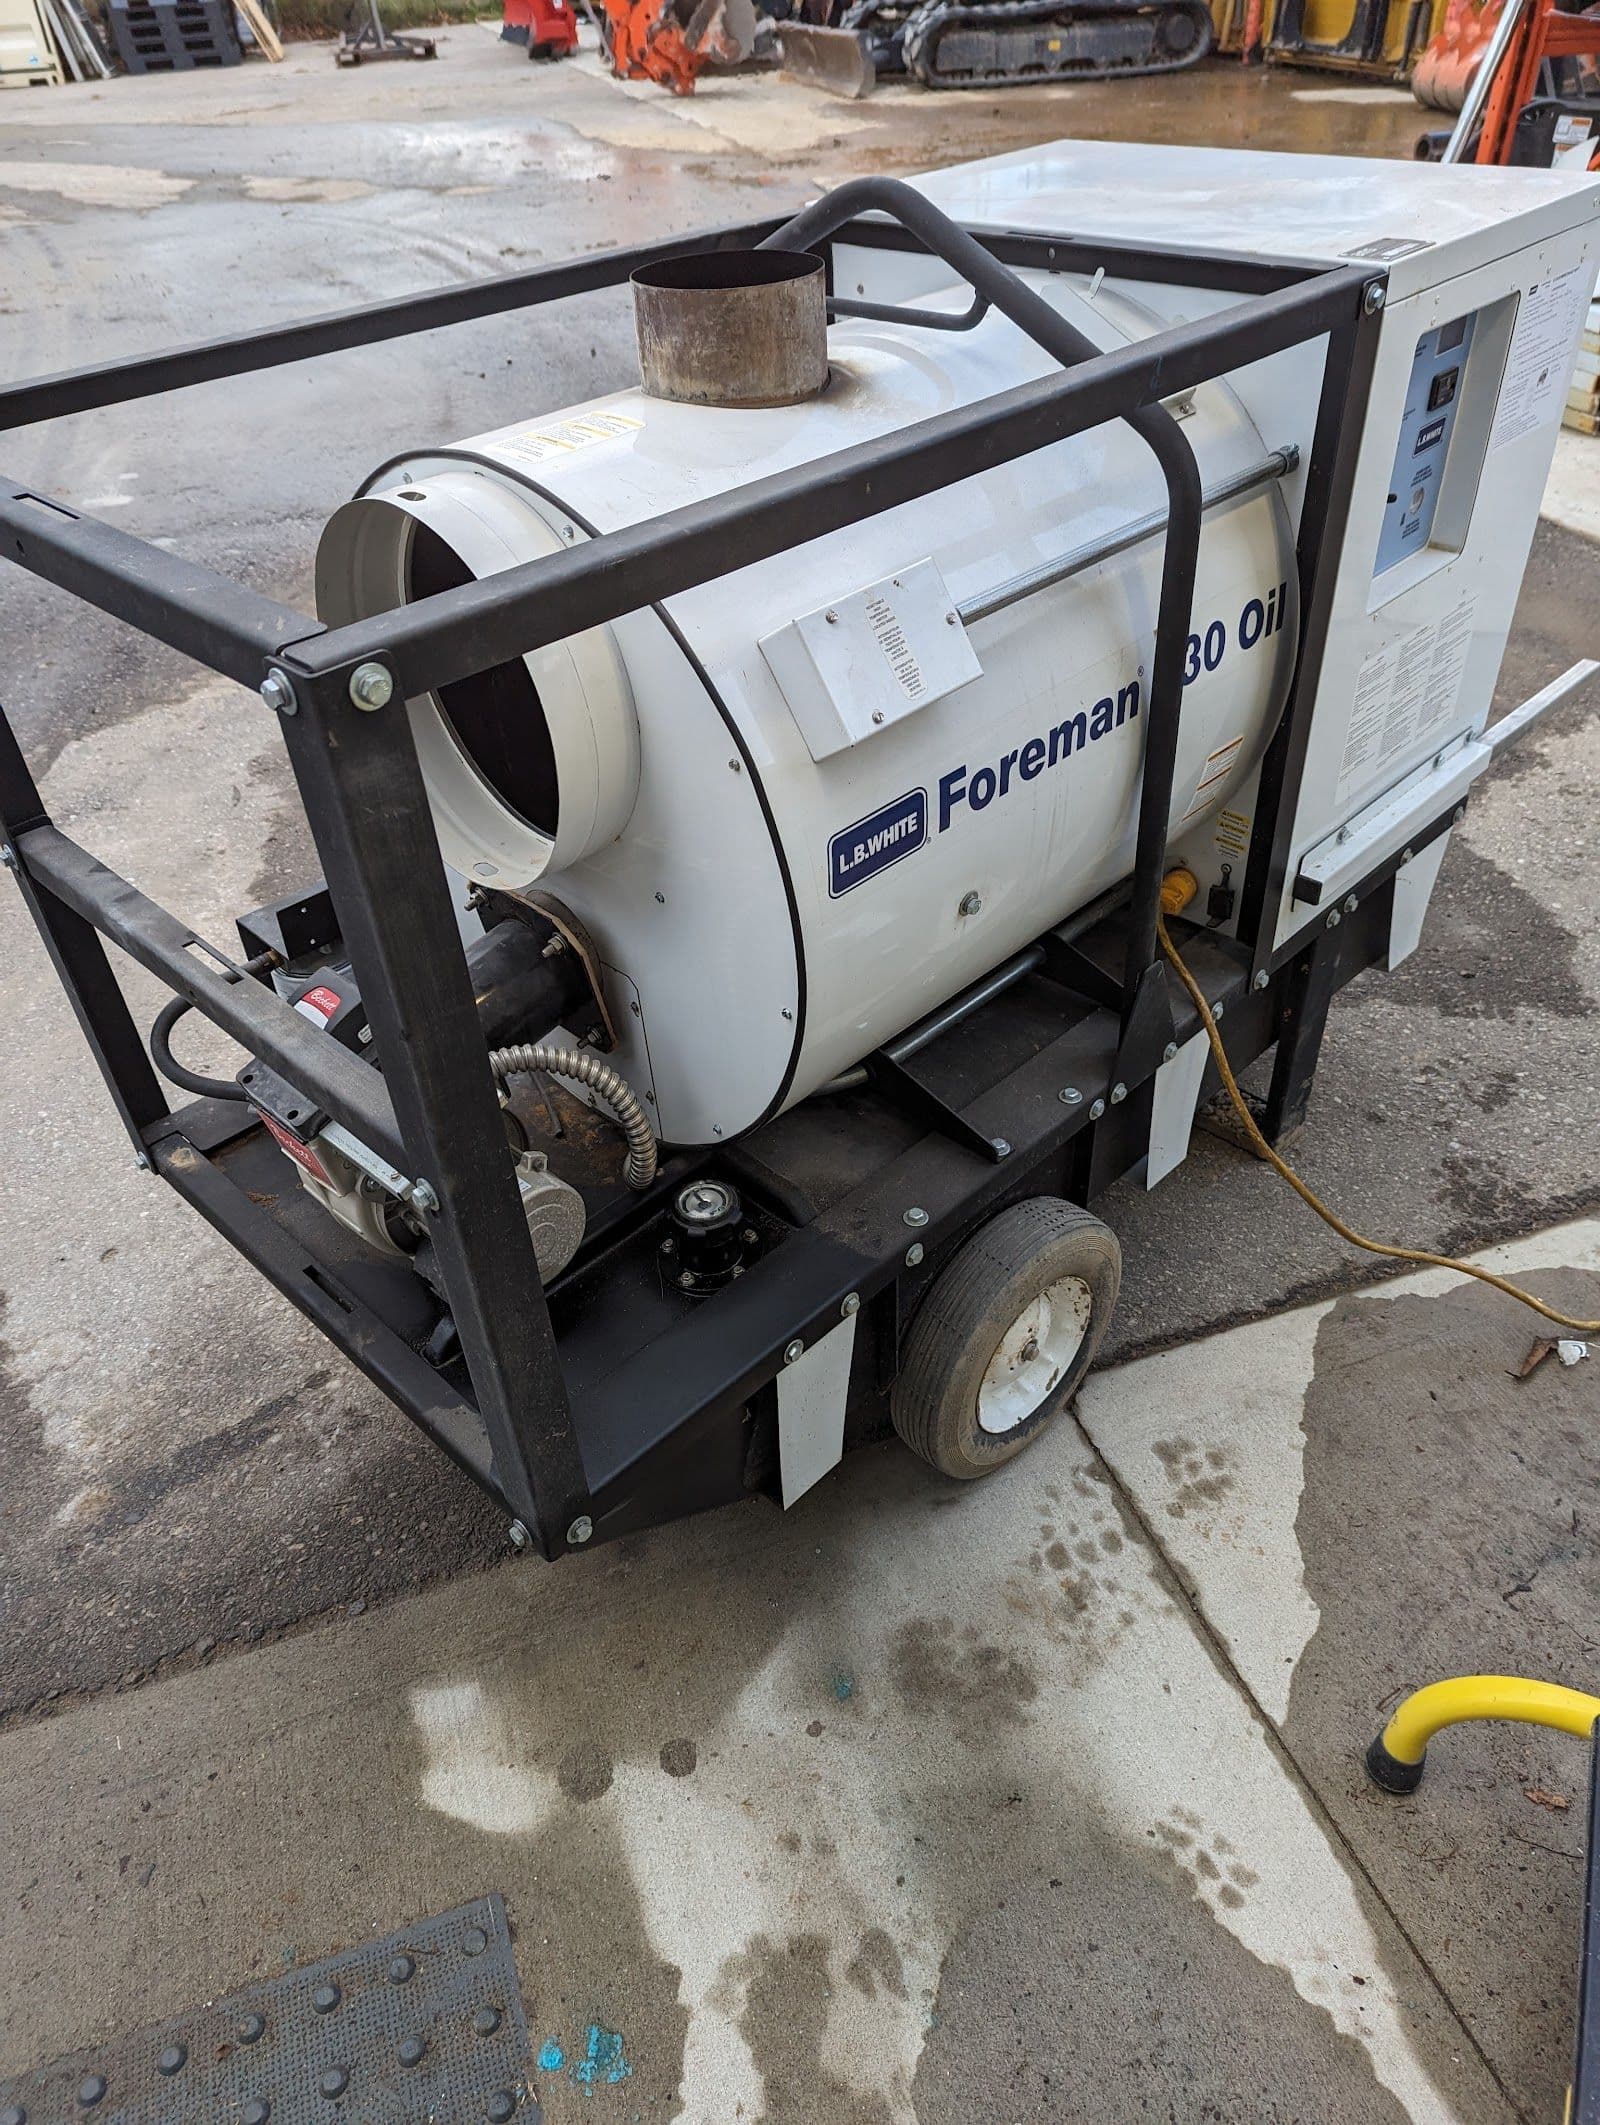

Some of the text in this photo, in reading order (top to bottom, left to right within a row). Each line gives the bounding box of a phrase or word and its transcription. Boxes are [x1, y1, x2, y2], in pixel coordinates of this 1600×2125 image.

[938, 680, 1140, 833] Foreman
[1239, 581, 1287, 650] Oil
[310, 988, 337, 1011] Beckett
